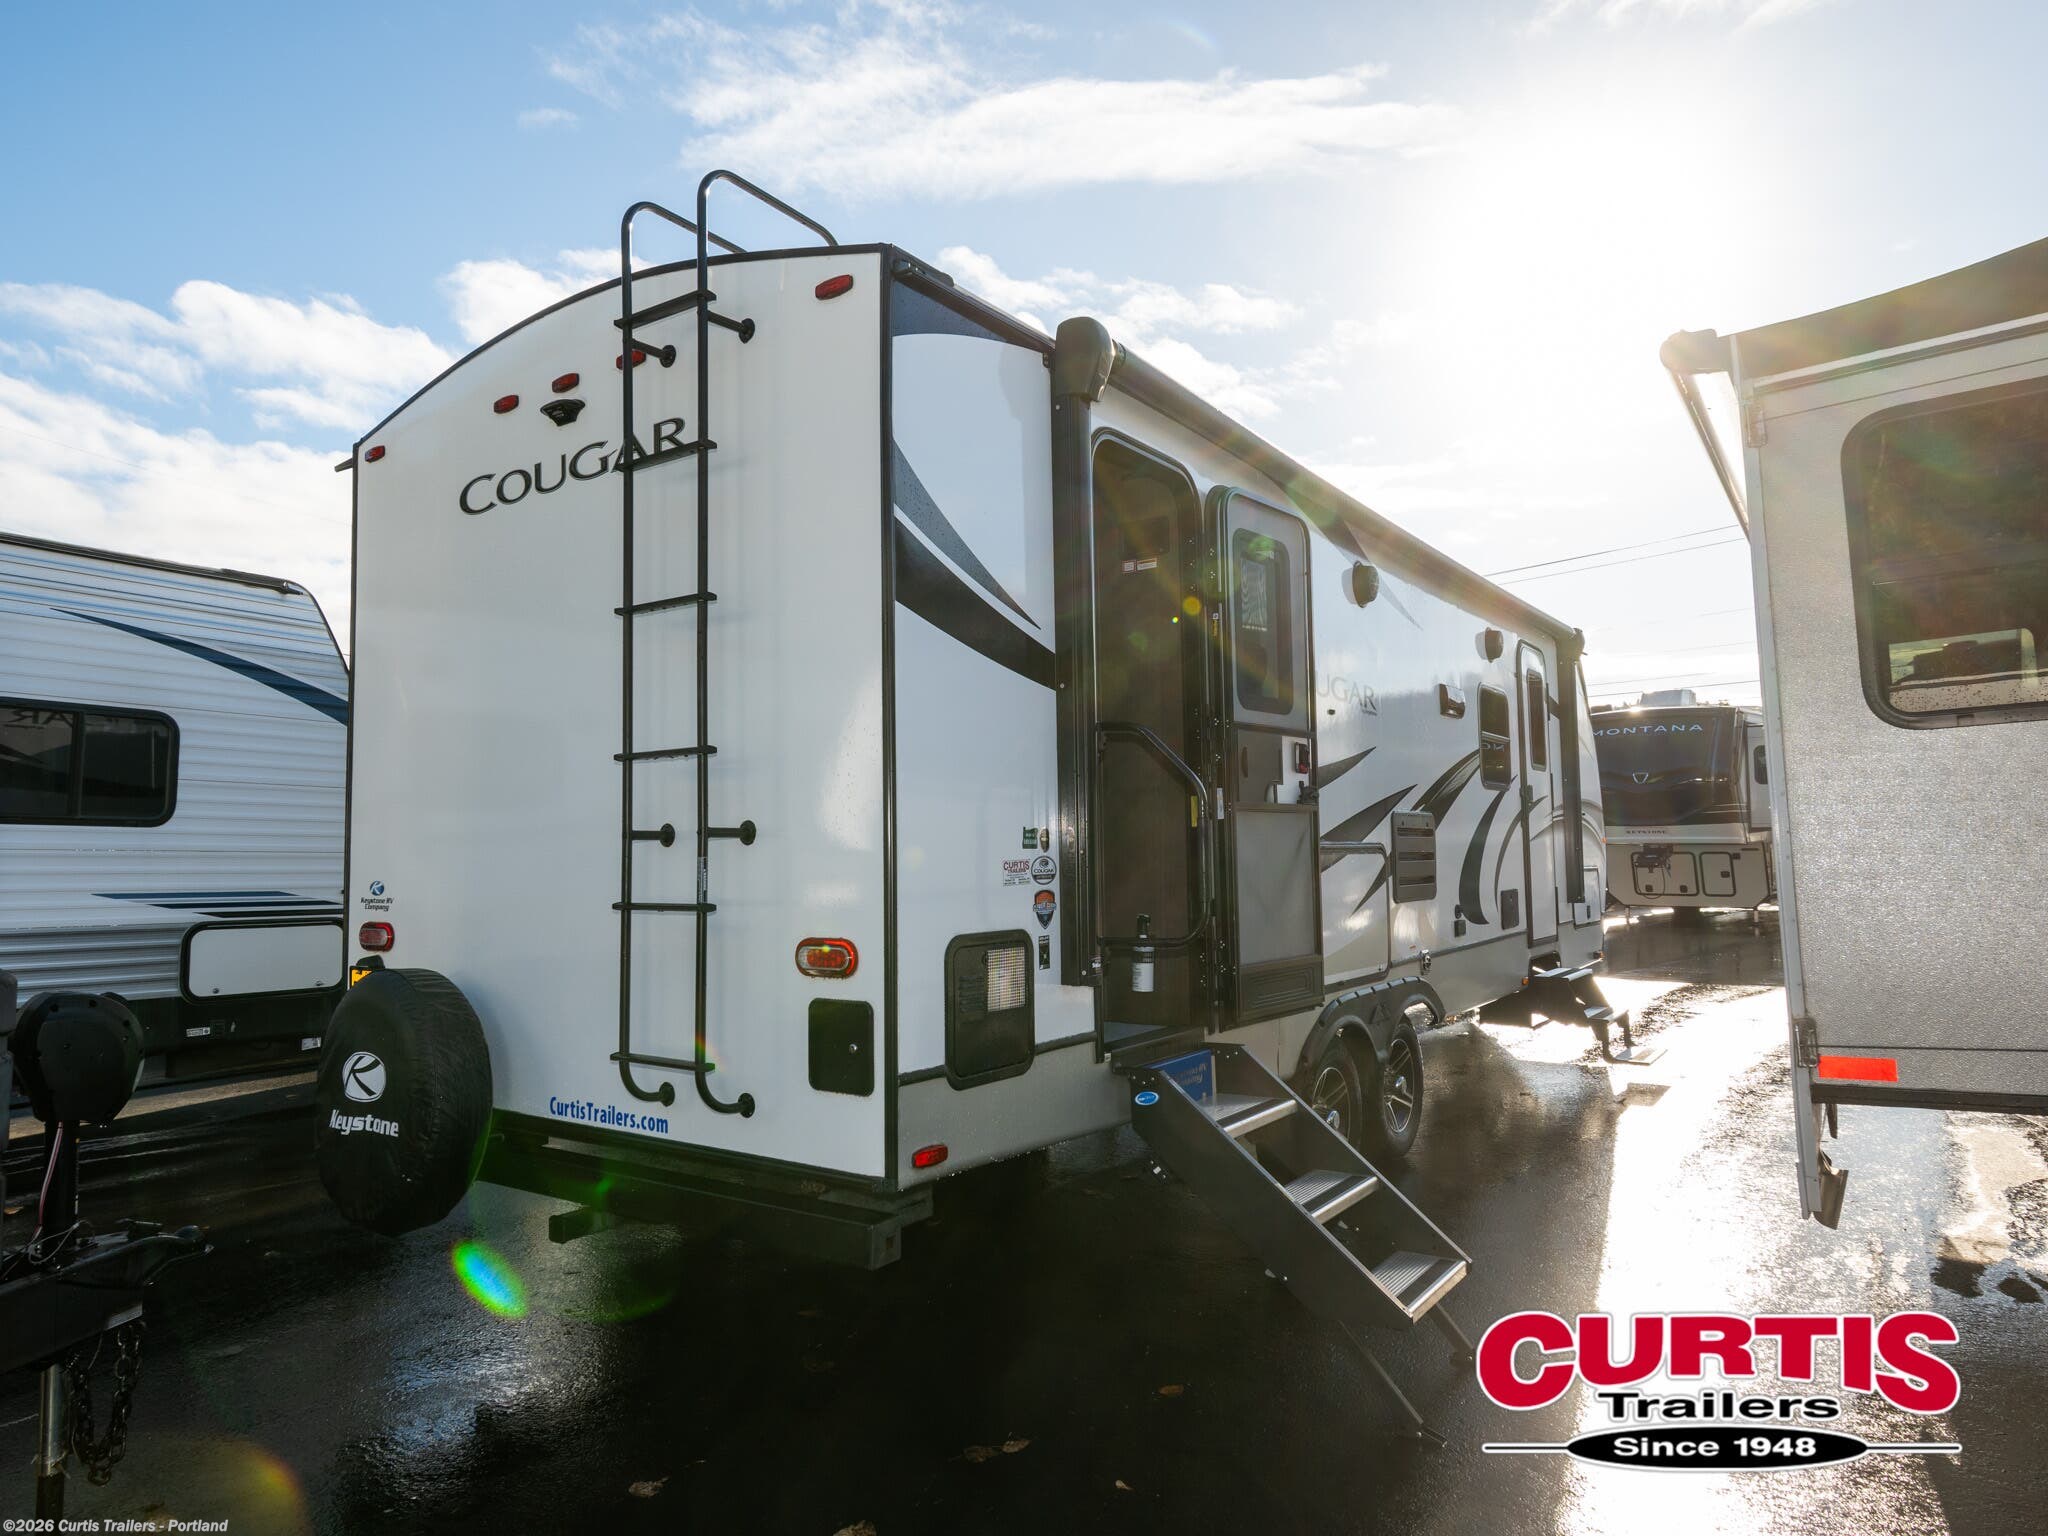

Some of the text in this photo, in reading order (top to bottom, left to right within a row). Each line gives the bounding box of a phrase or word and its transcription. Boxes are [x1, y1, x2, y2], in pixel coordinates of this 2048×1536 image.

[459, 417, 686, 516] COUGAR
[1317, 673, 1377, 711] UGAR
[1593, 724, 1703, 736] MONTANA
[1003, 860, 1030, 871] CURTIS
[329, 1109, 399, 1137] Keystone
[549, 1096, 669, 1134] CurtisTrailers.com
